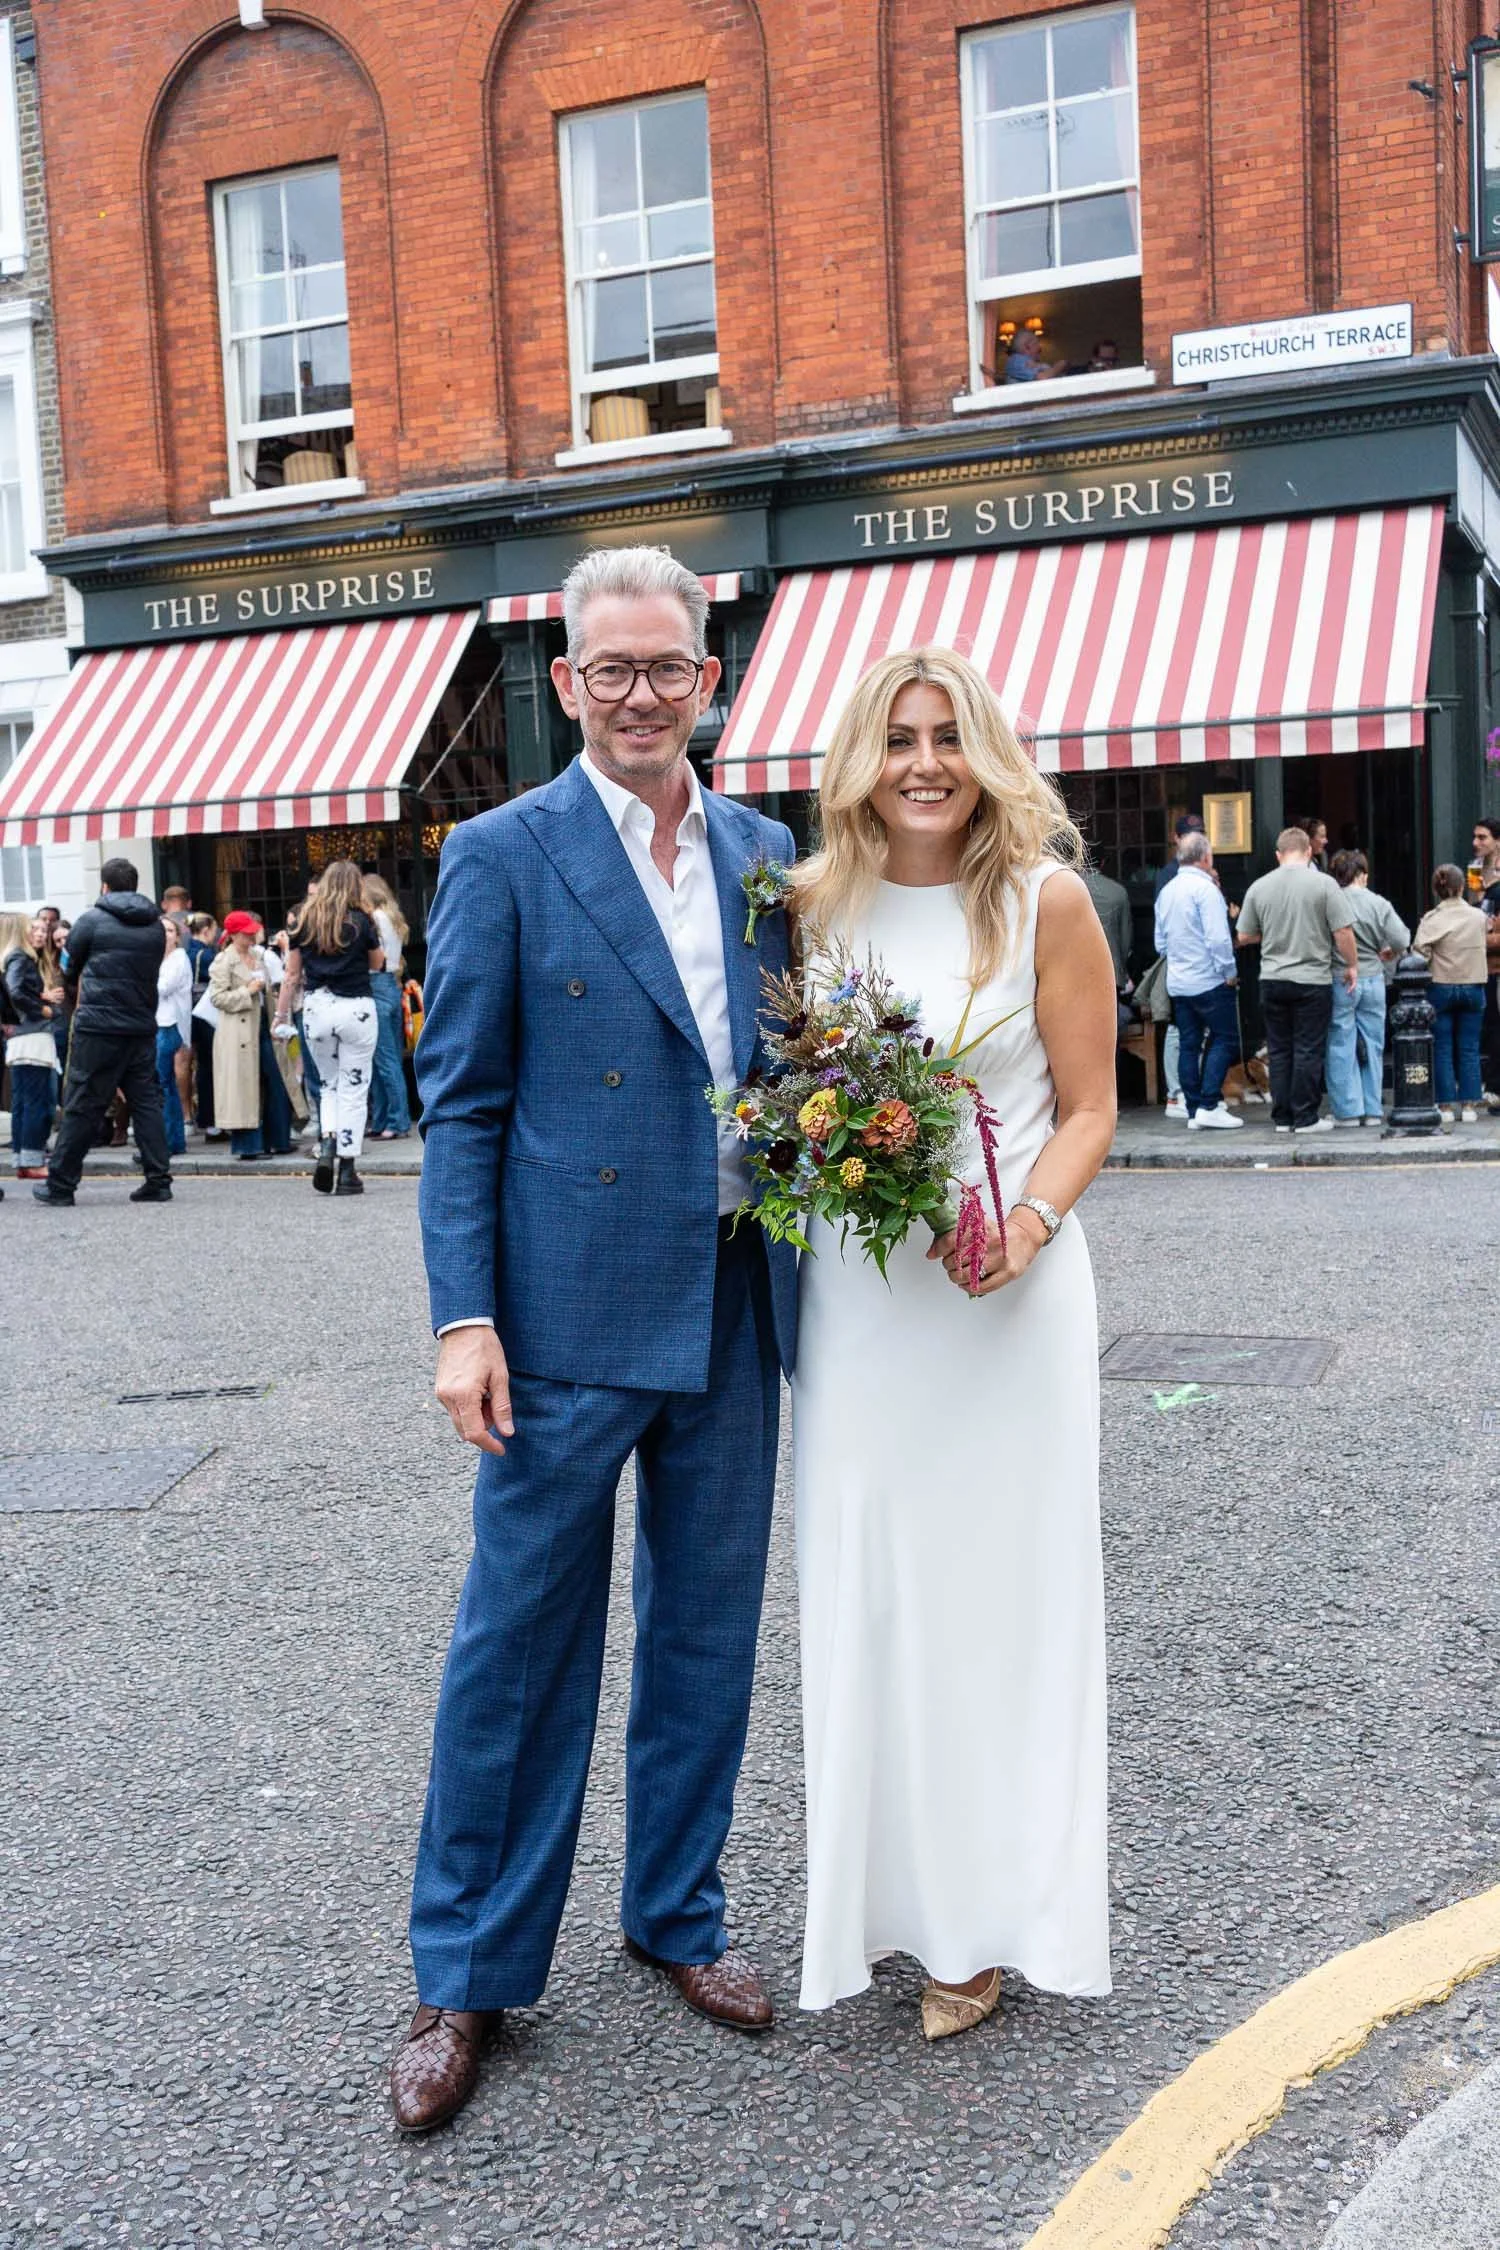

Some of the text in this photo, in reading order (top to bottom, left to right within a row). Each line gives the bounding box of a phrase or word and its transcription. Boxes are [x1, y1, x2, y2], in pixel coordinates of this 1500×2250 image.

[1177, 333, 1315, 368] CHRISTCHURCH
[1326, 321, 1407, 347] TERRACE
[854, 471, 1235, 547] THE SURPRISE
[144, 567, 435, 631] THE SURPRISE
[350, 1068, 362, 1086] 3
[341, 1128, 353, 1147] 3
